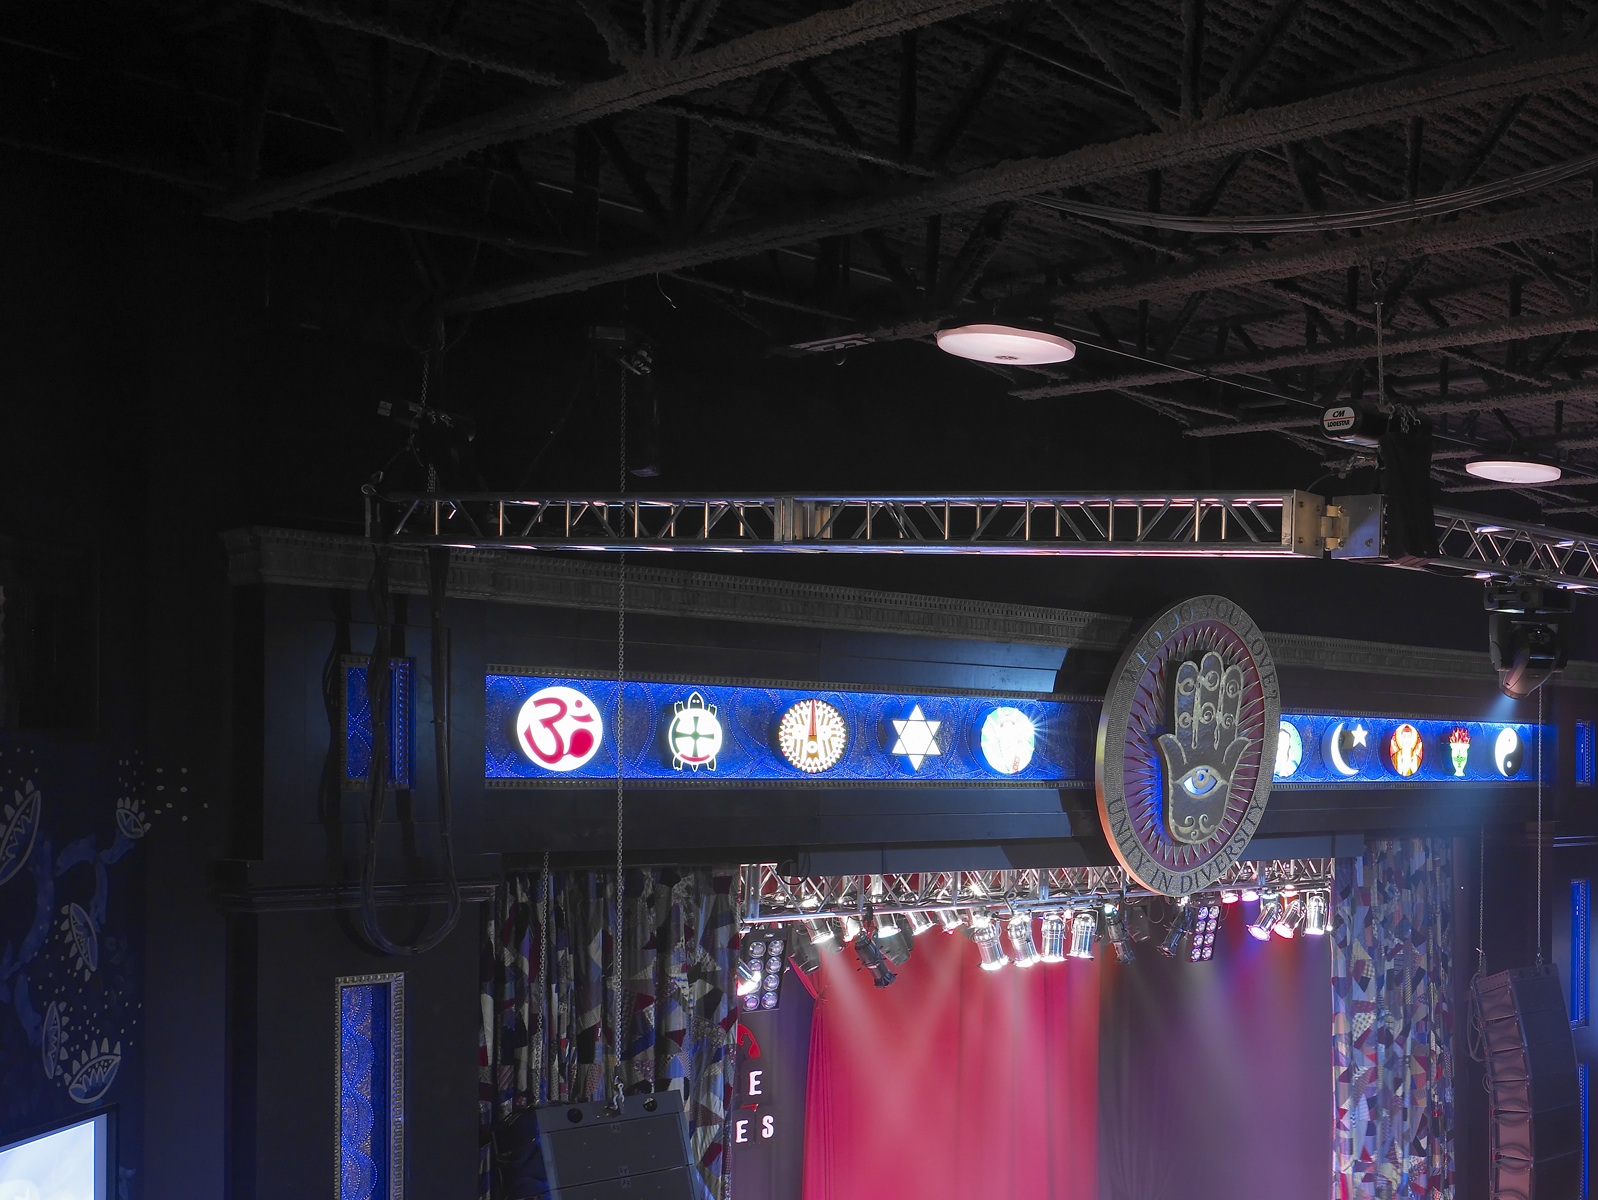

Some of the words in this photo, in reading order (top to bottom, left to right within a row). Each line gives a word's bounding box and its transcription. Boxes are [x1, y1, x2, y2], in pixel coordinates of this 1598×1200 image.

[1332, 410, 1346, 418] CM
[1121, 631, 1163, 682] WHO
[1168, 604, 1195, 632] DO
[1203, 598, 1242, 626] YOU
[1108, 798, 1151, 873] UNITY
[1149, 868, 1173, 893] IN
[1180, 797, 1264, 894] DIVERSITY
